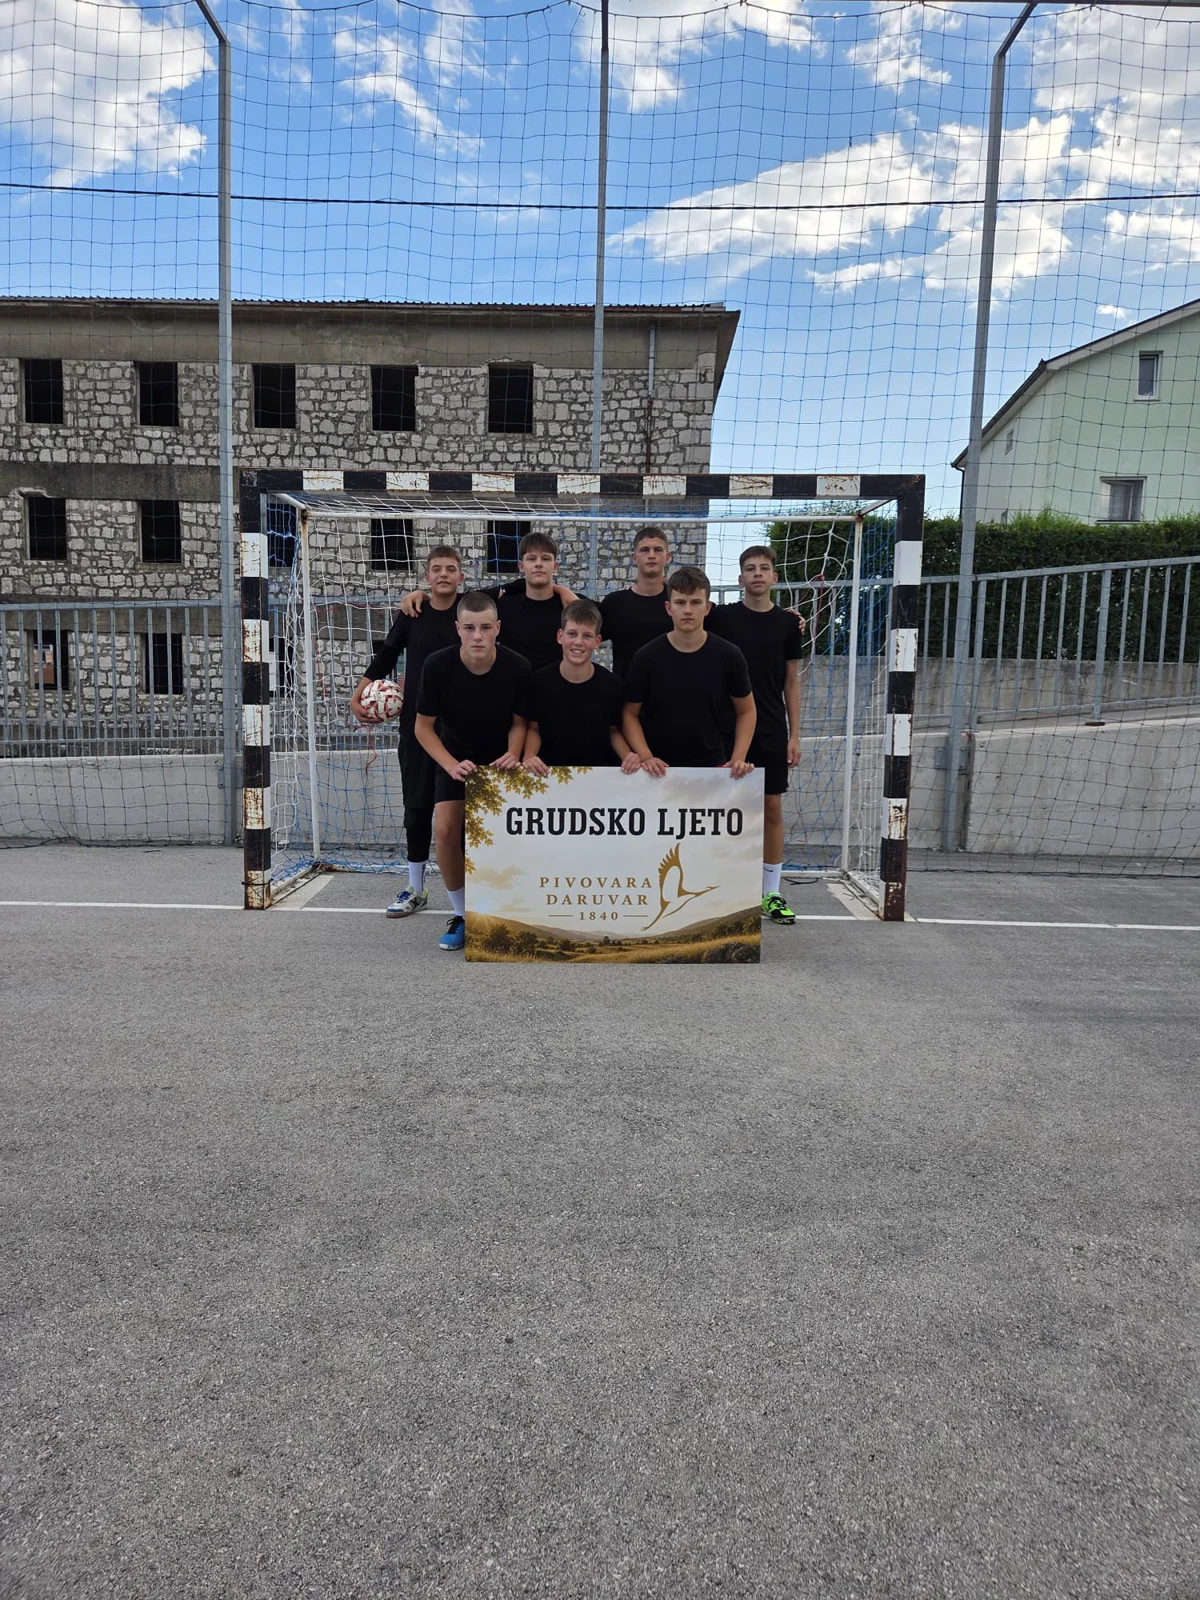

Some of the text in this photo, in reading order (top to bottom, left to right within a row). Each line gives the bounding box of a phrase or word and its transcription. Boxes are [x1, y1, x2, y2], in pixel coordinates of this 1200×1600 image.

[506, 807, 743, 840] GRUDSKO LJETO
[539, 876, 652, 889] PIVOVARA
[546, 894, 648, 906] DARUVAR
[579, 911, 619, 921] 1840
